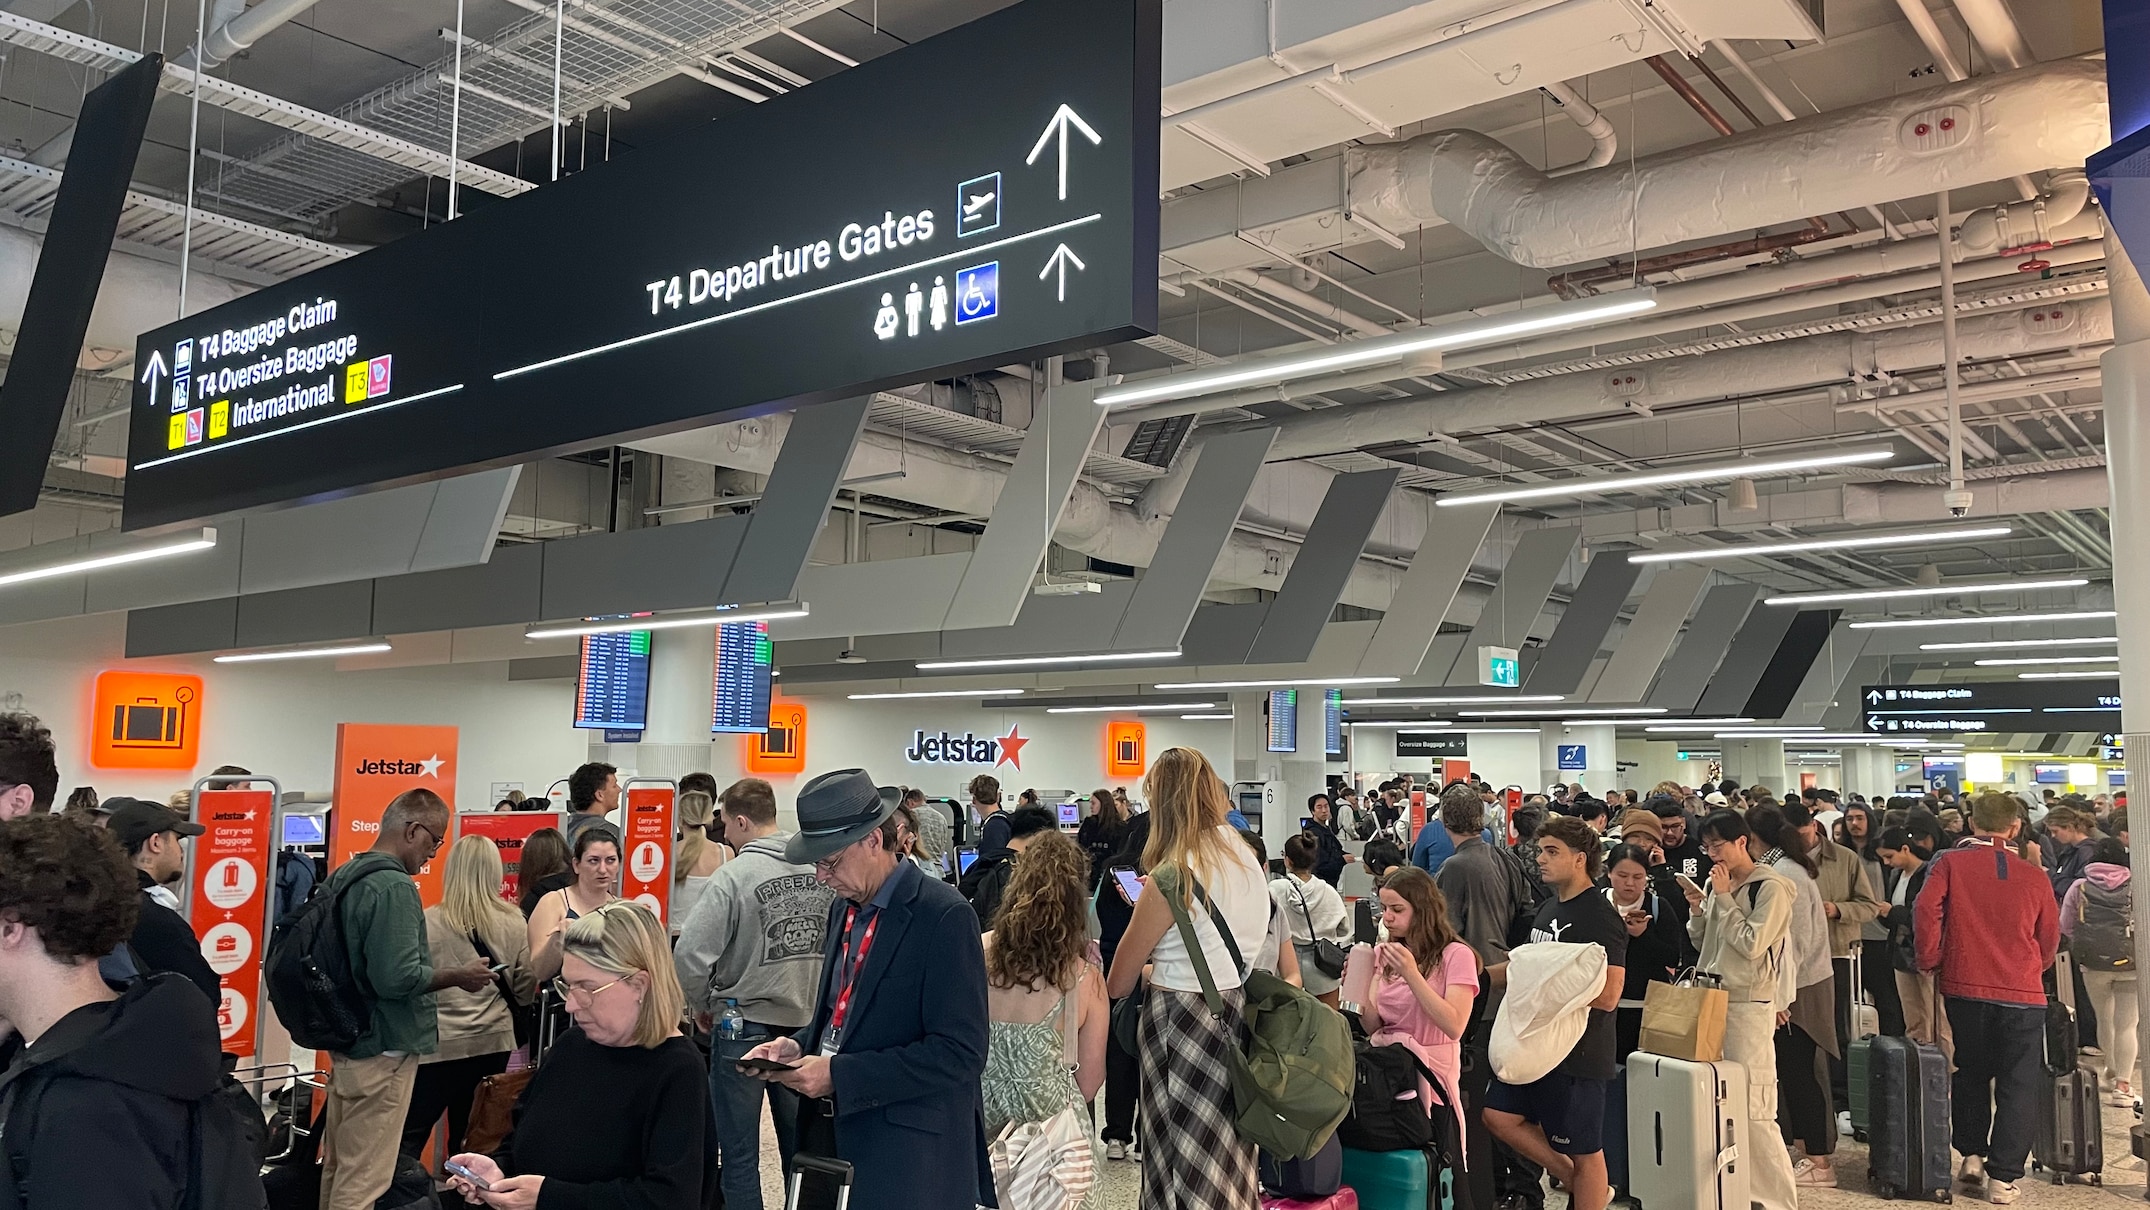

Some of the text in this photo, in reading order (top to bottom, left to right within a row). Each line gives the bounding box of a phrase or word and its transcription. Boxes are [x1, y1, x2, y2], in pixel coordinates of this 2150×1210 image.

[646, 208, 934, 315] T4 Departure Gates
[199, 297, 337, 362] T4 Baggage Claim
[197, 334, 357, 400] T4 Oversize Baggage
[172, 423, 184, 441] T1
[213, 410, 225, 429] T2
[233, 375, 335, 429] International
[349, 371, 366, 393] T3
[1900, 688, 1972, 700] T4 Baggage Claim
[2098, 696, 2113, 706] T4
[1902, 720, 1986, 730] T4 Oversize Baggage
[907, 731, 998, 762] Jetstar
[1399, 740, 1446, 749] Oversize Baggage
[356, 758, 424, 775] Jetstar
[1266, 788, 1274, 804] 6
[212, 811, 246, 821] Jetstar
[637, 816, 662, 826] Carry-on
[214, 827, 254, 838] Carry-on
[351, 820, 380, 834] Step
[636, 825, 662, 833] baggage
[214, 836, 253, 847] baggage
